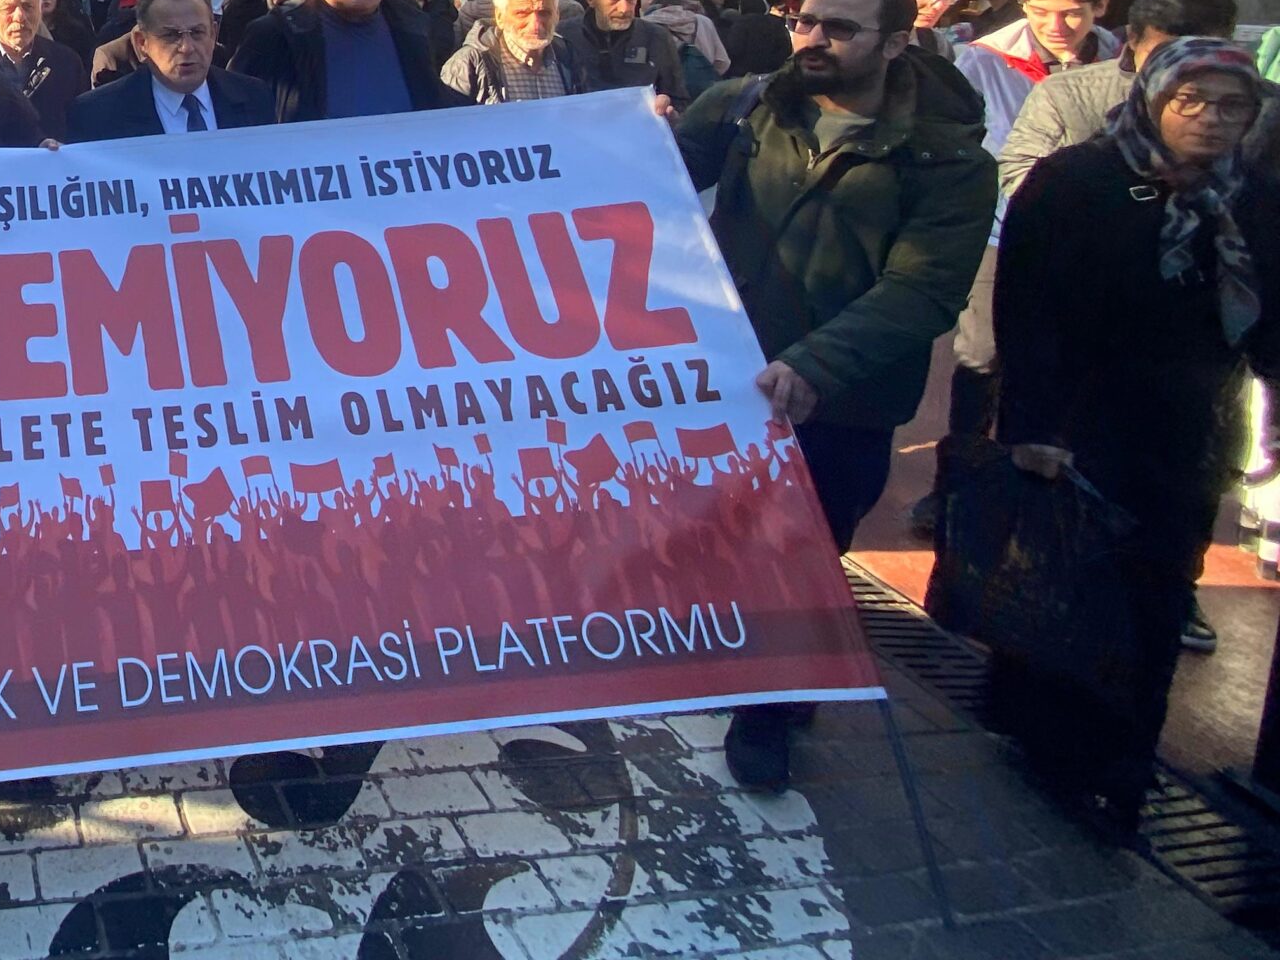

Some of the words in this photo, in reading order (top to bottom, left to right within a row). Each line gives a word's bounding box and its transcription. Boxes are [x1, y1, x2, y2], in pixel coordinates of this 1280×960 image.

[159, 164, 353, 211] HAKKIMIZI
[358, 143, 562, 197] İSTİYORUZ
[132, 390, 314, 452] TESLİM
[340, 355, 721, 436] OLMAYACAĞIZ
[32, 660, 99, 716] VE
[117, 619, 420, 709] DEMOKRASİ
[433, 600, 748, 675] PLATFORMU
